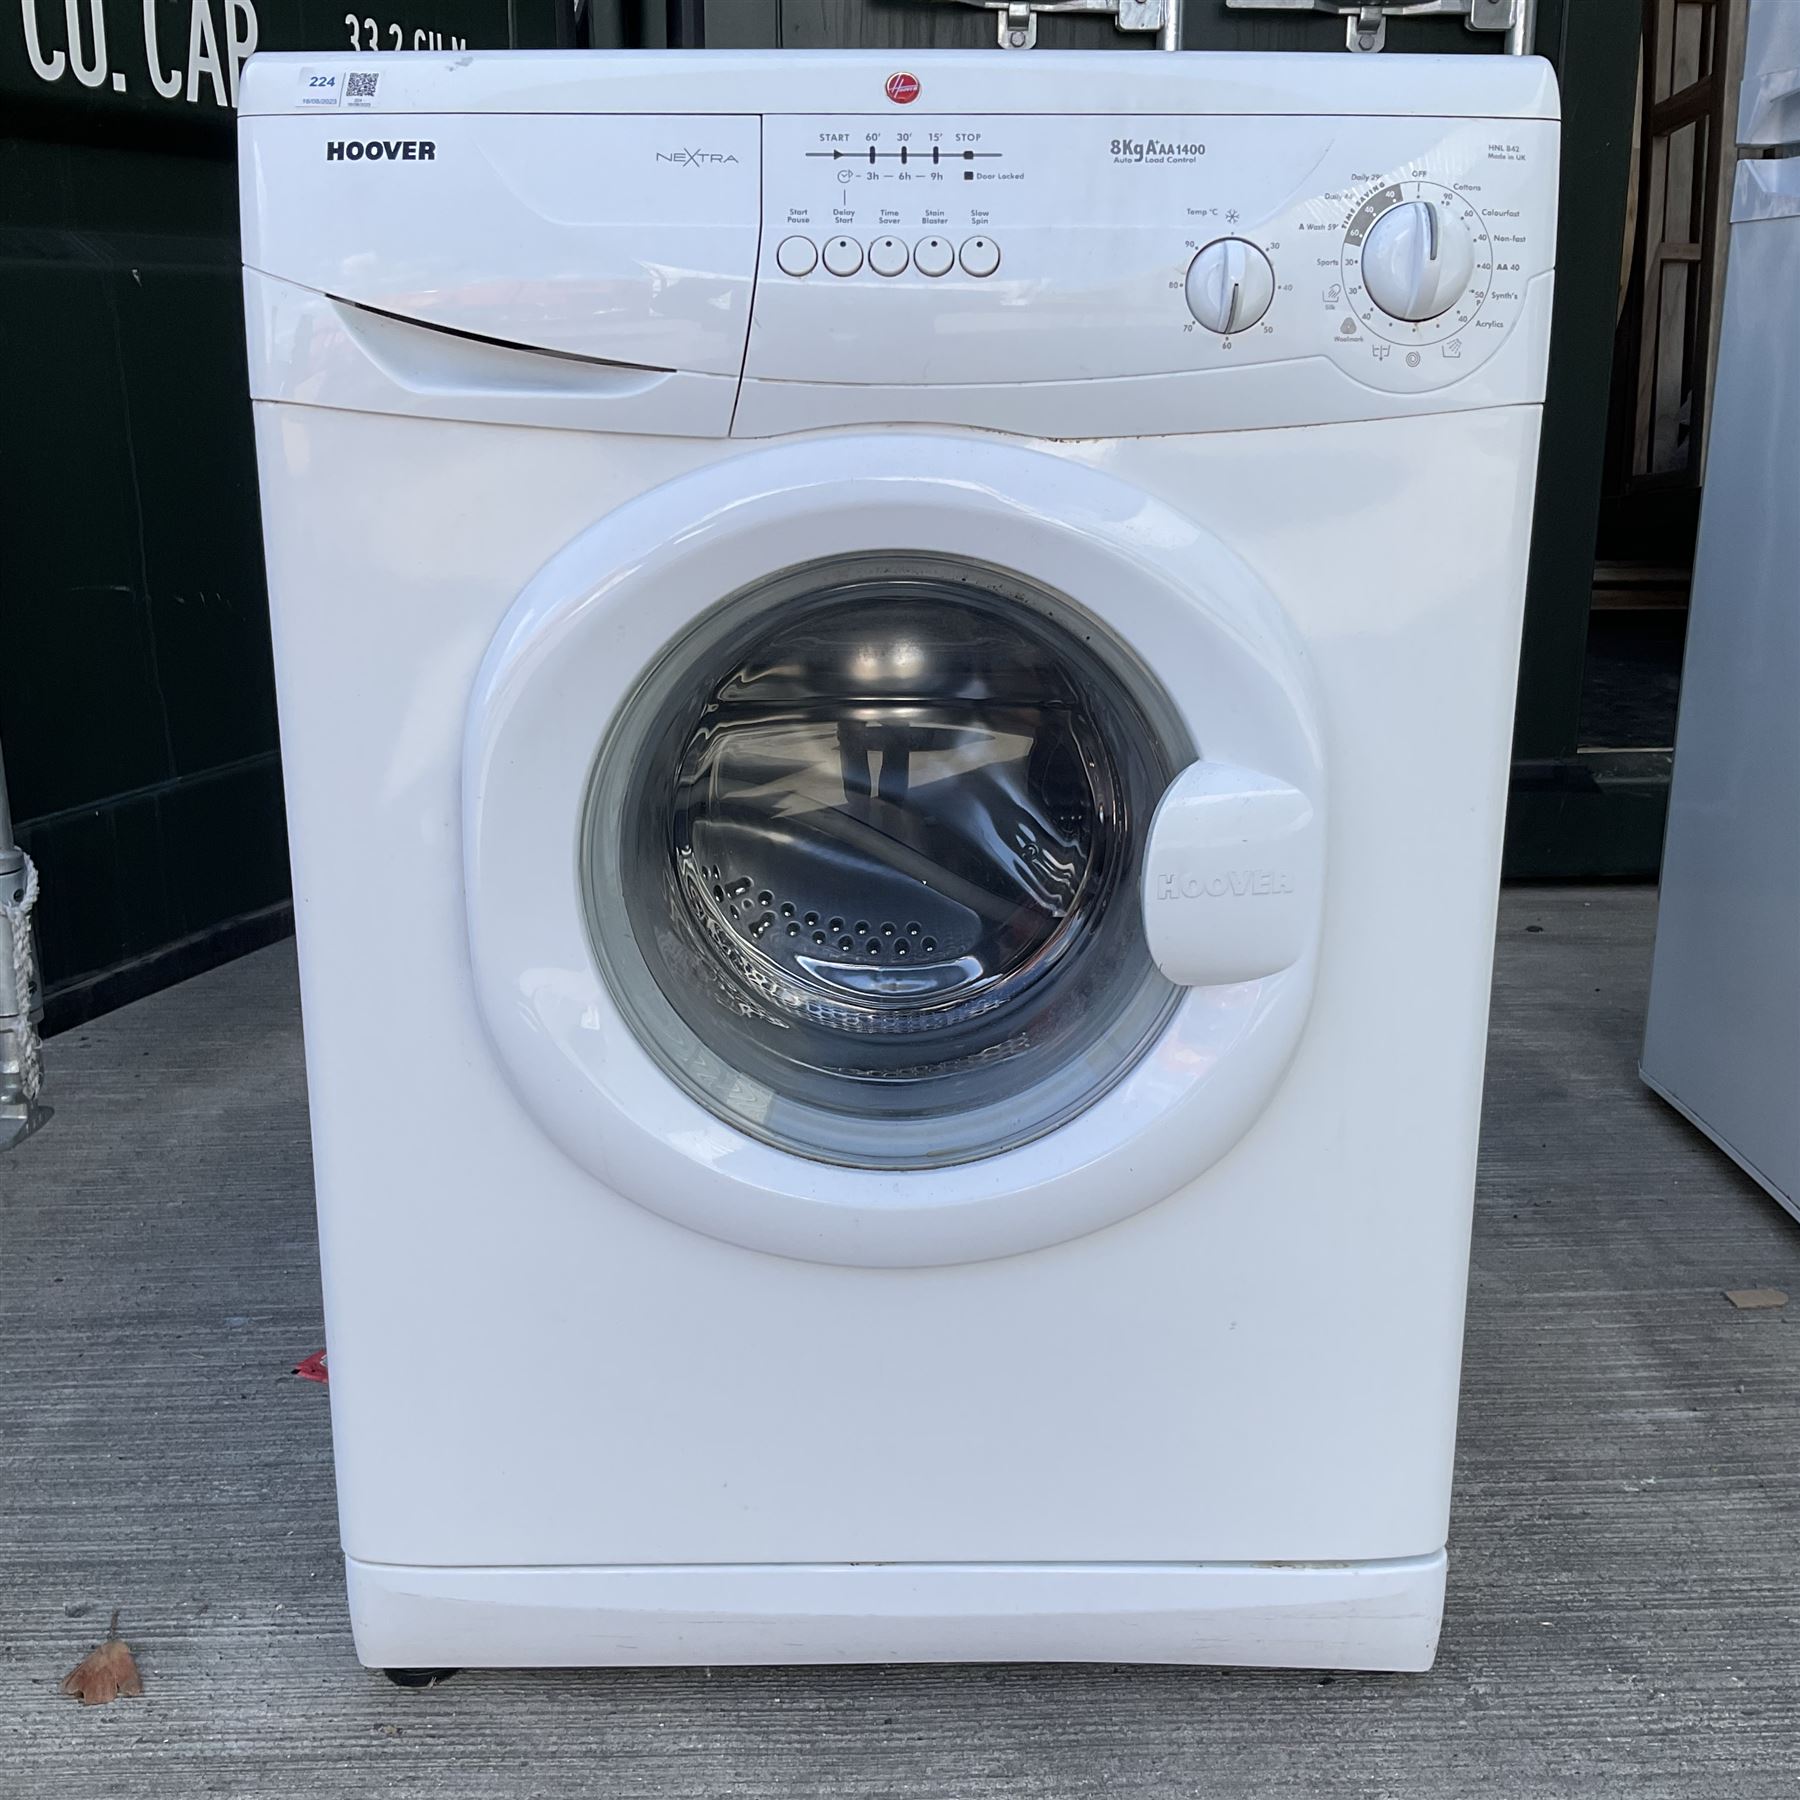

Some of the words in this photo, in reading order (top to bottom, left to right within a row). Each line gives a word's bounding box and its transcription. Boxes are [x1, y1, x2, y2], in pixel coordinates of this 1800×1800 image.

[143, 0, 258, 108] CAP
[309, 76, 336, 87] 224
[819, 133, 850, 142] START
[955, 133, 982, 142] STOP
[327, 141, 436, 161] HOOVER
[866, 171, 879, 181] 3h
[898, 171, 911, 181] 6h
[930, 172, 943, 181] 9h
[998, 172, 1025, 180] Locked
[1351, 173, 1369, 182] Daily
[1411, 170, 1427, 178] OFF
[1453, 183, 1481, 191] Cottons
[1385, 190, 1396, 198] 40
[1341, 208, 1356, 230] TIME
[1356, 181, 1385, 207] SAVING
[832, 208, 856, 217] Delay
[970, 209, 990, 217] Slow
[1187, 208, 1207, 216] Temp
[1481, 208, 1520, 217] Colourfast
[971, 217, 989, 225] Spin
[1306, 223, 1326, 231] Wash
[1493, 234, 1526, 243] Non-fast
[1185, 240, 1195, 248] 90
[1316, 258, 1339, 267] Sports
[1345, 258, 1354, 266] 30
[1496, 263, 1508, 271] AA
[1510, 263, 1520, 271] 40
[1168, 281, 1178, 289] 80
[1348, 287, 1358, 295] 30
[1475, 291, 1484, 299] 50
[1491, 291, 1518, 300] Synth's
[1458, 315, 1468, 323] 40
[1183, 324, 1193, 332] 70
[1475, 320, 1504, 329] Acrylics
[1263, 326, 1273, 334] 50
[1222, 342, 1232, 350] 60
[1158, 869, 1295, 900] HOOVER
